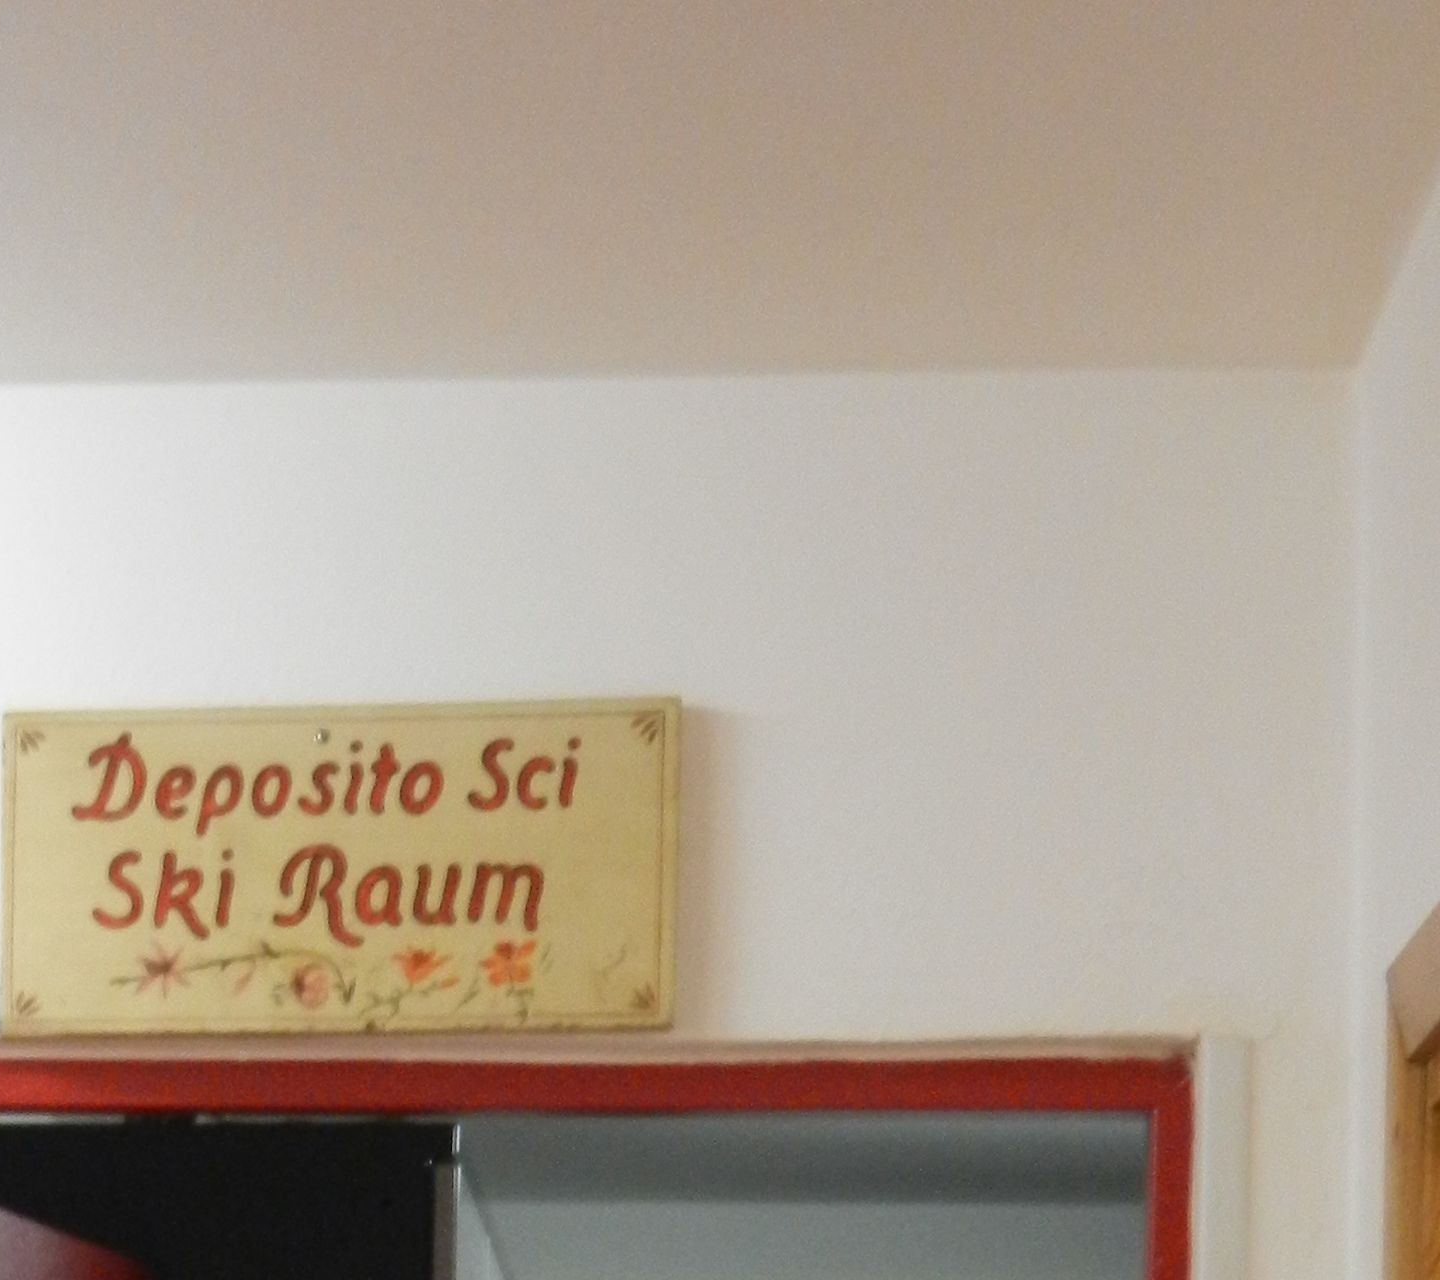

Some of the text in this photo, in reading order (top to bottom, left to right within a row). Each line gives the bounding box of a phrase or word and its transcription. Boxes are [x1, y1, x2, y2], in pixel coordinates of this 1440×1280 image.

[71, 731, 583, 836] Deposito Sci
[92, 843, 545, 947] Ski Raum
